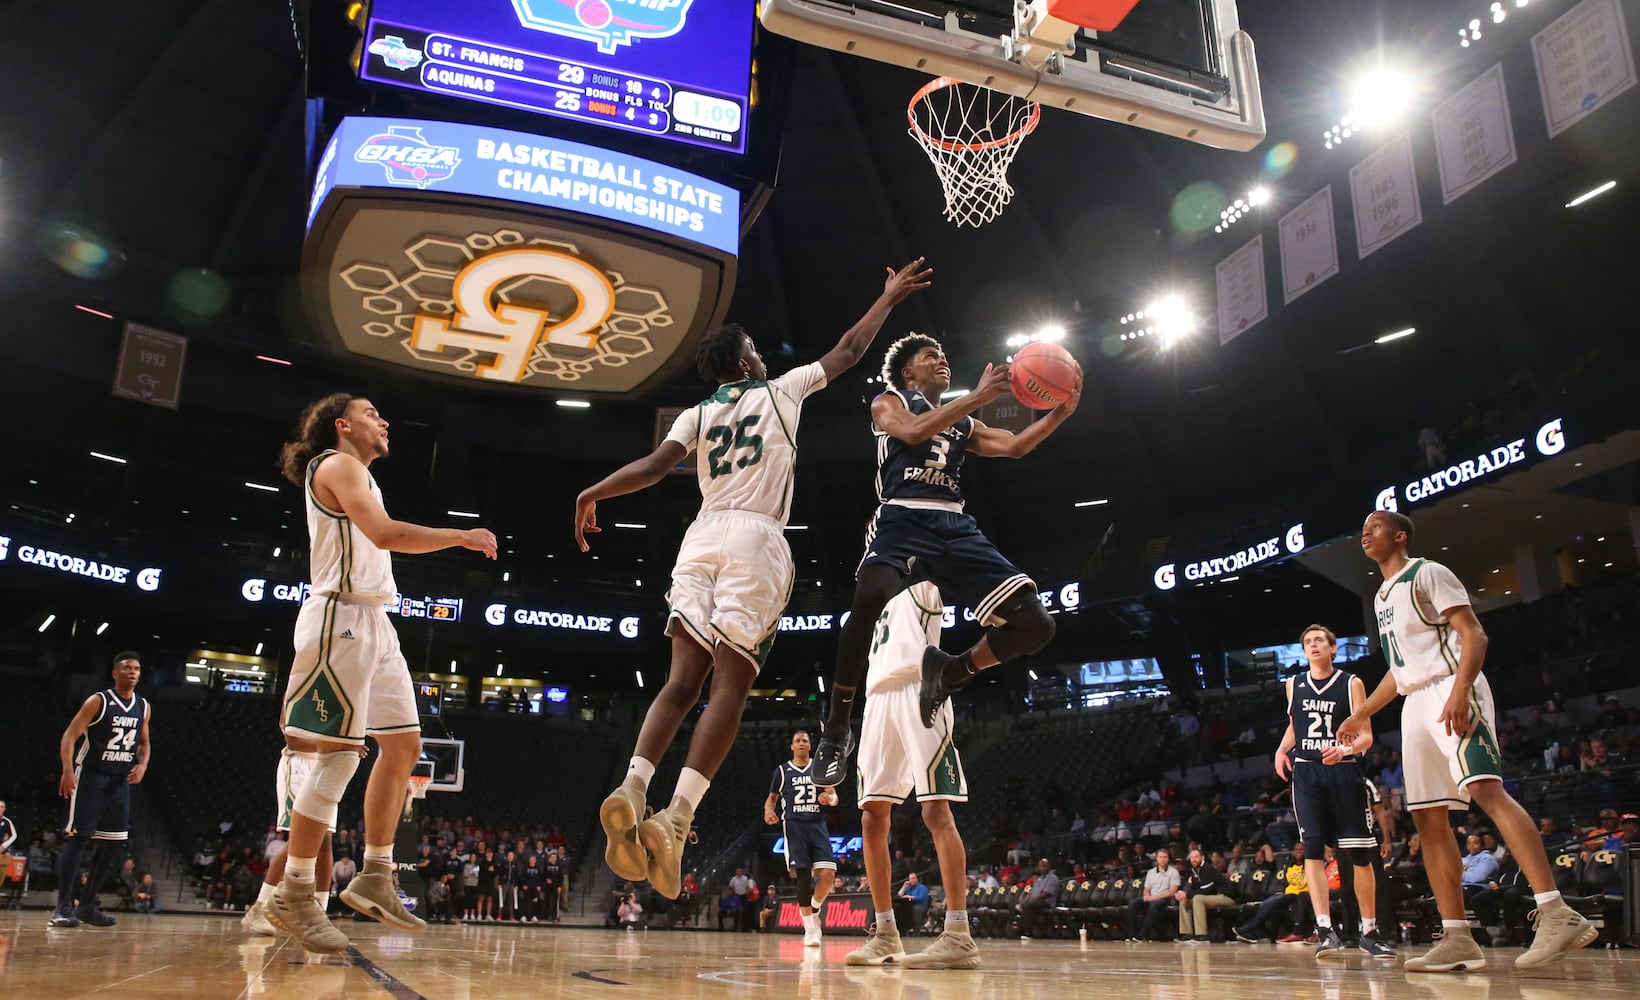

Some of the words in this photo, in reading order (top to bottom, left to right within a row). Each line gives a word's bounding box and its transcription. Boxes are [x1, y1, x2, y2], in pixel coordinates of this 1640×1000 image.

[431, 41, 455, 58] ST.
[460, 46, 525, 72] FRANCIS
[558, 63, 584, 84] 29
[592, 73, 620, 88] BONUS
[626, 80, 642, 94] 10
[651, 88, 660, 99] 4
[427, 68, 496, 92] AQUINAS
[554, 91, 581, 111] 25
[588, 101, 617, 115] BONUS
[625, 108, 635, 121] 4
[649, 114, 659, 126] 3
[585, 87, 619, 102] BONUS
[624, 95, 643, 107] FLS
[648, 100, 665, 111] TOL
[692, 100, 737, 126] 1:09
[674, 123, 692, 135] 2ND
[694, 128, 732, 142] QUARTER
[358, 145, 455, 166] GHSA
[477, 138, 647, 190] BASKETBALL
[652, 175, 723, 215] STATE
[1370, 175, 1396, 202] 1985
[498, 168, 704, 232] CHAMPIONSHIPS
[1372, 194, 1399, 221] 1996
[140, 349, 166, 368] 1992
[994, 405, 1018, 420] 2012
[706, 414, 763, 480] 25
[924, 435, 950, 471] 3
[1405, 437, 1527, 502] GATORADE
[18, 545, 130, 584] GATORADE
[1185, 537, 1280, 582] GATORADE
[412, 600, 426, 608] TOL
[433, 606, 449, 618] 29
[514, 609, 614, 632] GATORADE
[1379, 606, 1394, 628] RISH
[1302, 699, 1337, 713] SAINT
[112, 716, 139, 728] SAINT
[1308, 712, 1334, 738] 21
[107, 727, 137, 750] 24
[1302, 739, 1341, 750] FRANCI
[792, 776, 813, 786] SAIN
[794, 785, 817, 804] 23
[825, 900, 868, 927] Wilson
